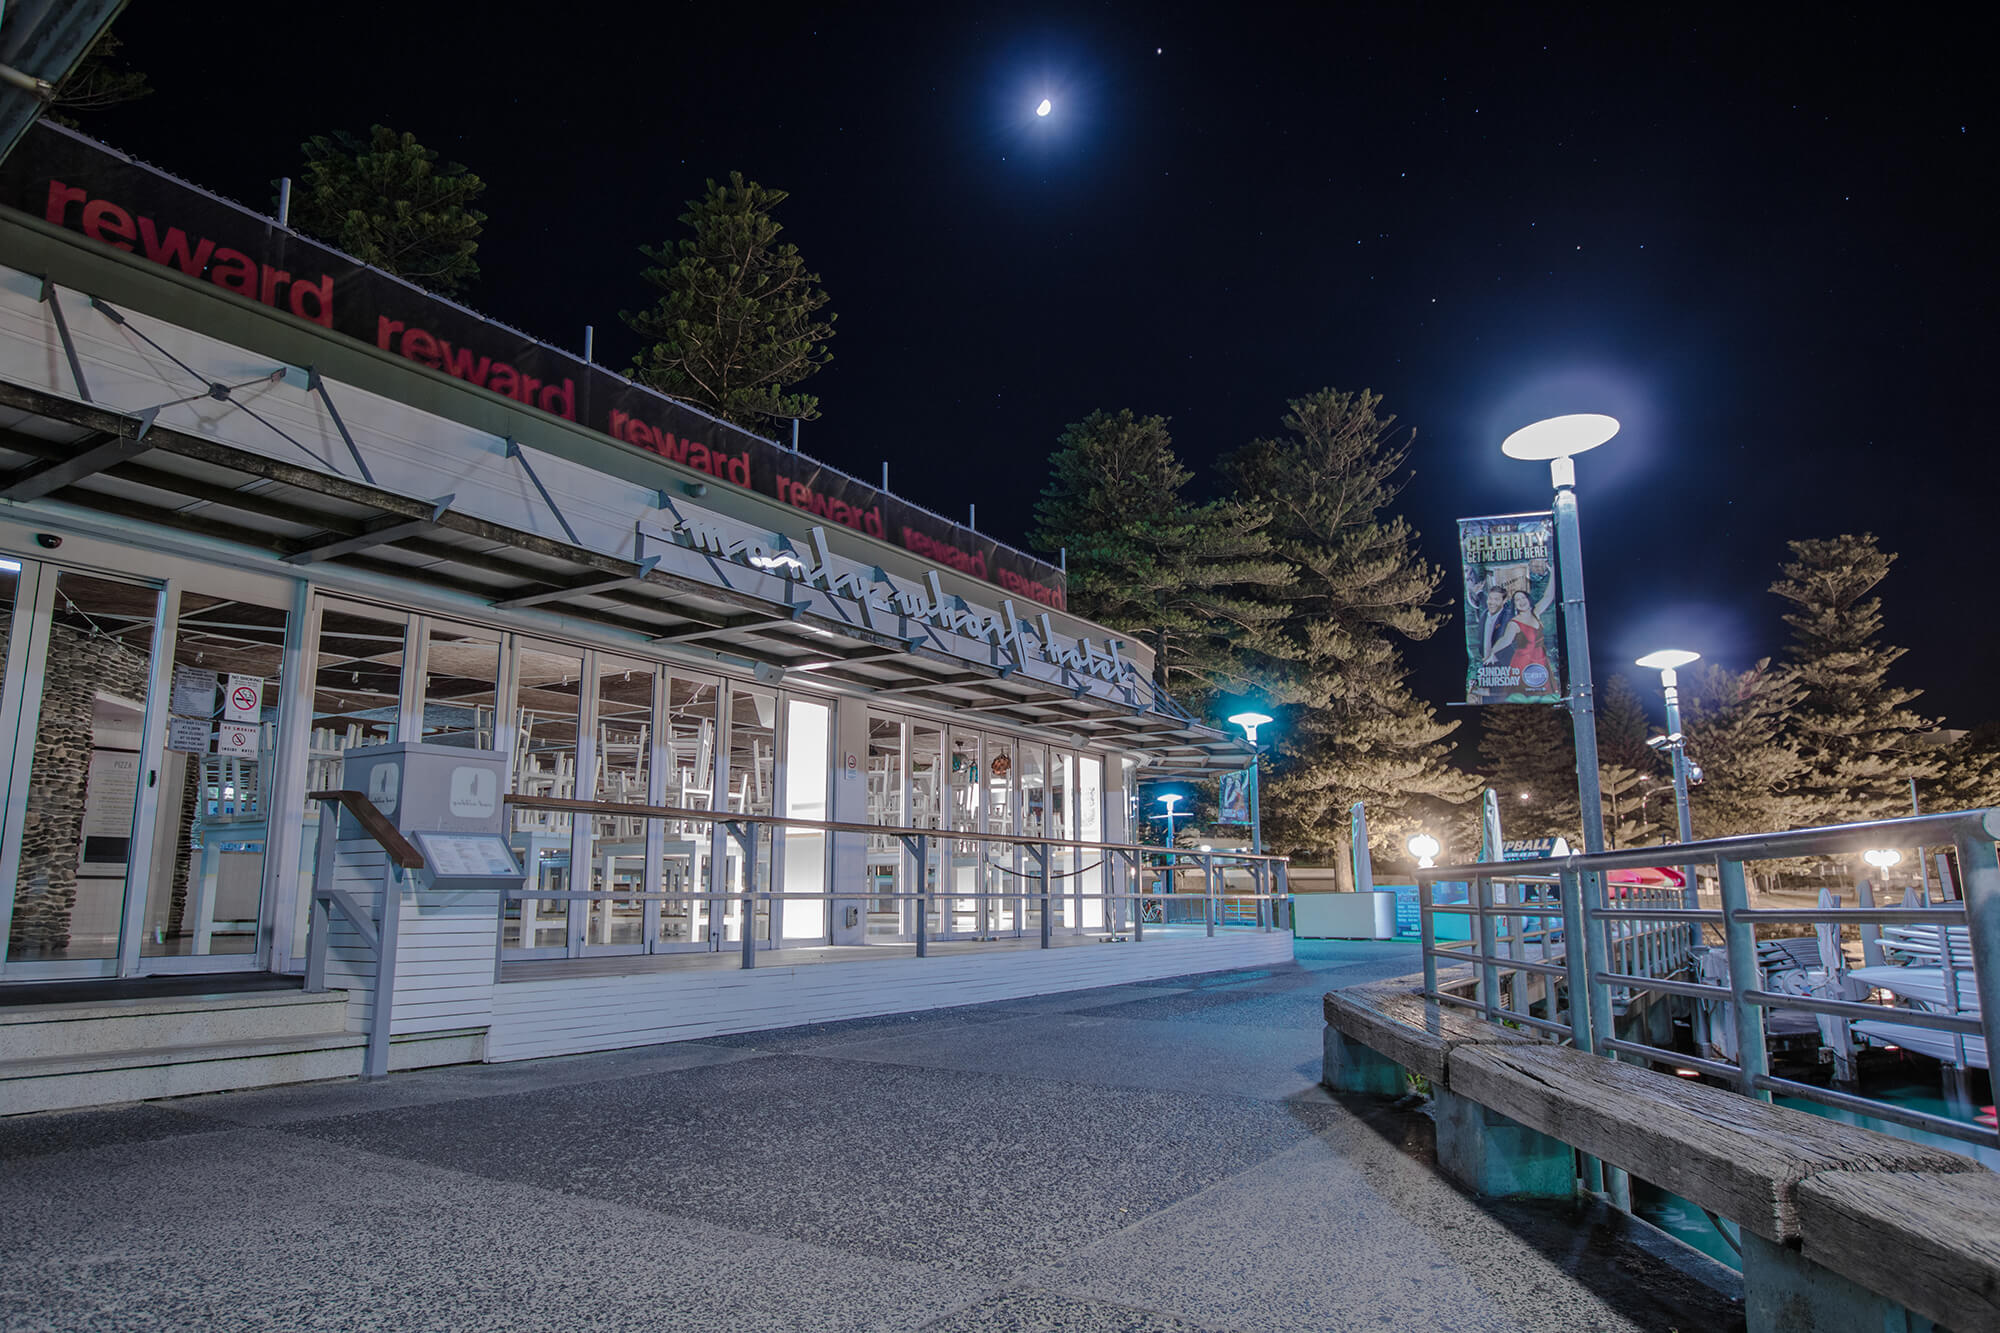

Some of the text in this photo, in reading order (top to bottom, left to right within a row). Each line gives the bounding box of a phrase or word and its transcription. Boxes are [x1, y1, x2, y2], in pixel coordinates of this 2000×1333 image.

[46, 179, 334, 328] reward
[377, 314, 576, 422] reward
[609, 408, 752, 488] reward
[776, 475, 884, 540] reward
[902, 527, 987, 580] reward
[1467, 532, 1545, 552] CELEBRITY
[1467, 551, 1481, 563] GET
[1482, 549, 1496, 562] ME
[1496, 547, 1512, 561] OUT
[1512, 547, 1523, 560] OF
[1000, 567, 1066, 611] reward
[1477, 666, 1511, 677] SUNDAY
[1511, 667, 1520, 675] TO
[1477, 675, 1520, 687] THURSDAY
[114, 761, 132, 769] PIZZA
